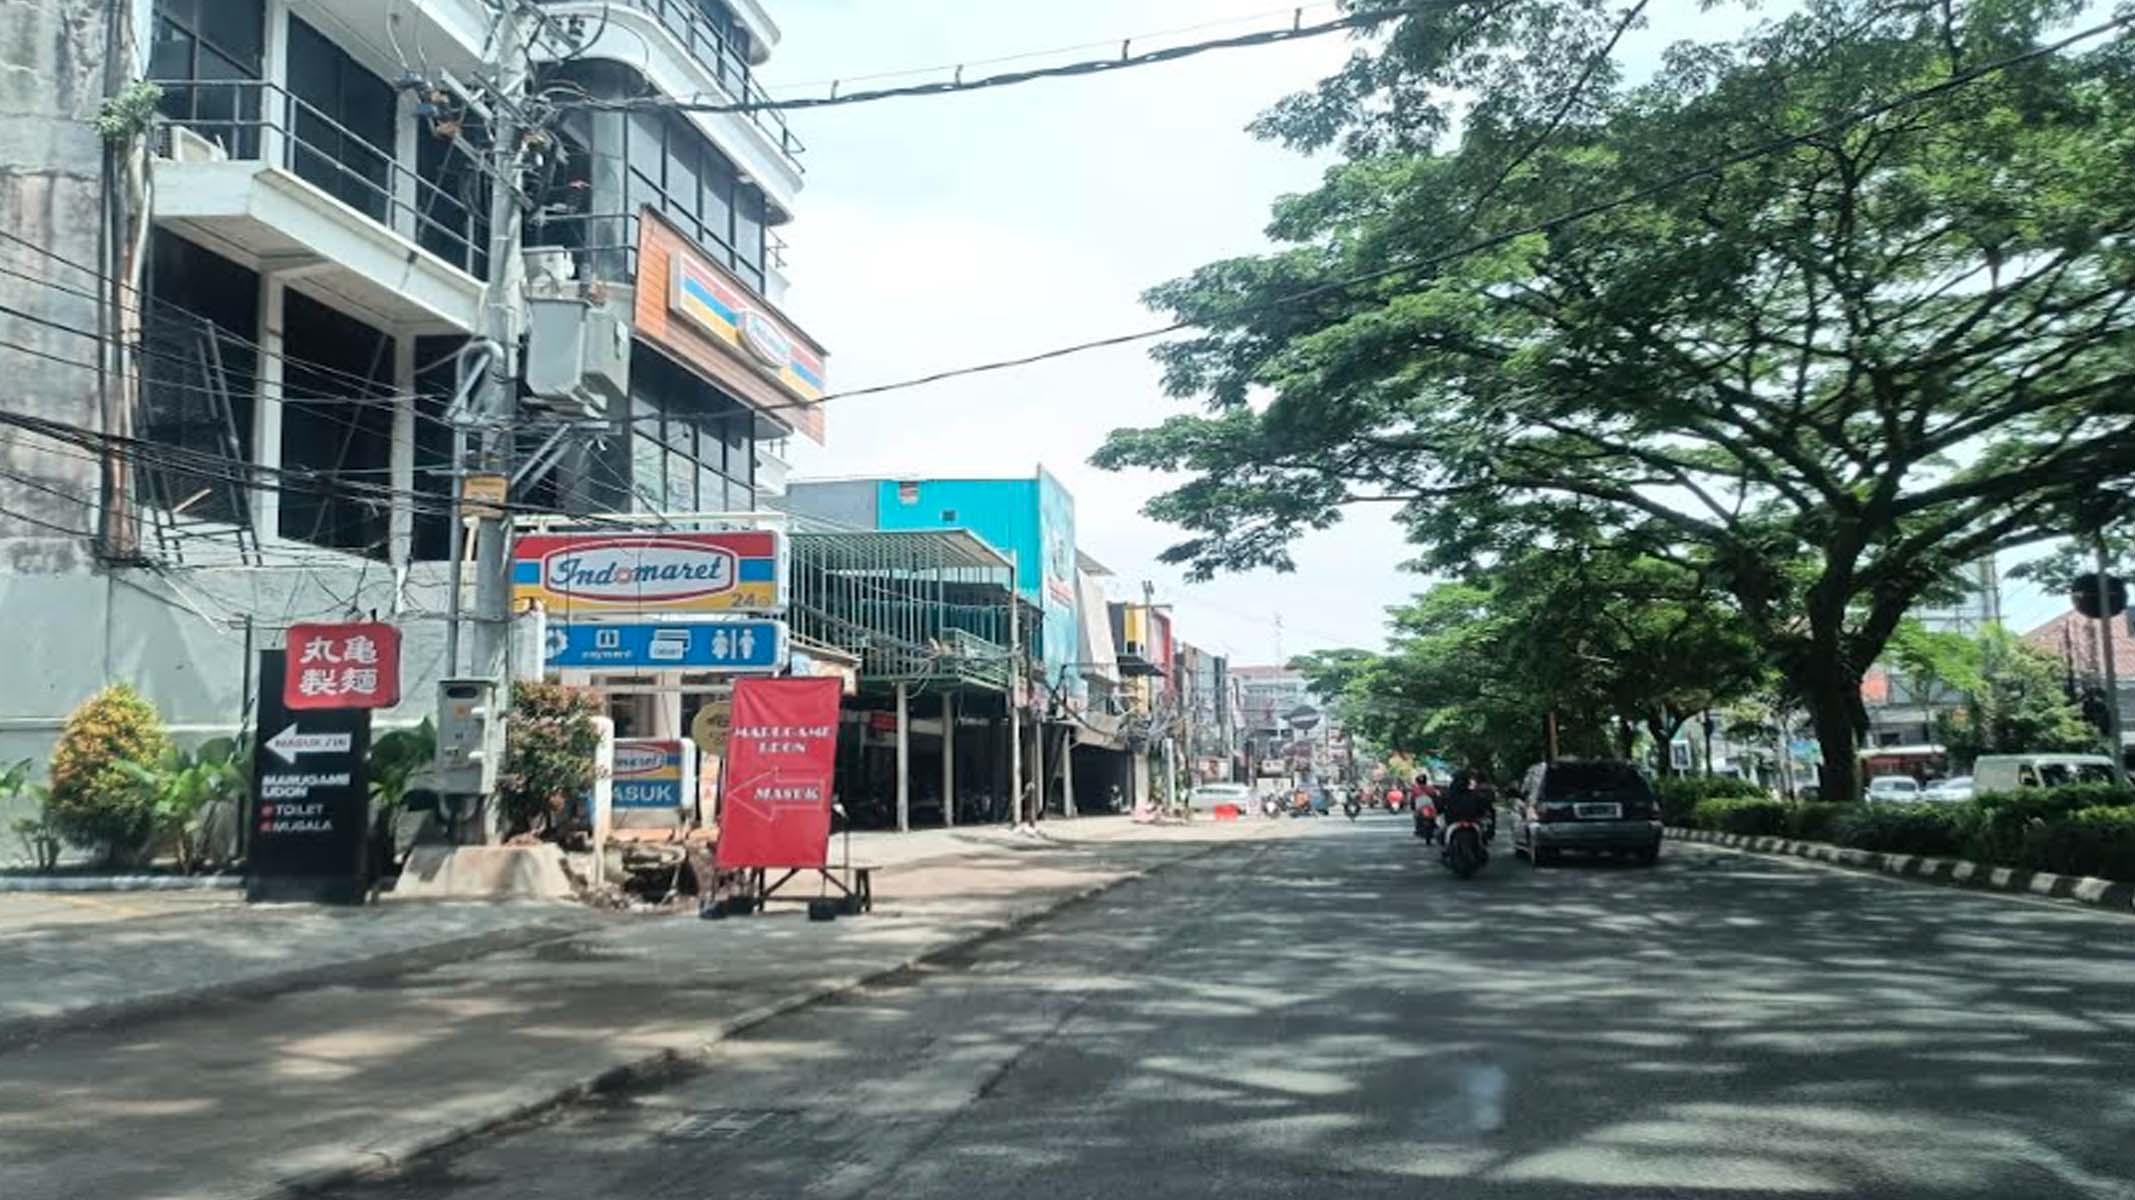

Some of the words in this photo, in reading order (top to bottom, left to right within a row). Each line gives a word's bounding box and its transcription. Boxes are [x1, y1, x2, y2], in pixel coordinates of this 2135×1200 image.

[550, 557, 722, 585] Indomaret
[299, 636, 378, 664] 丸亀
[261, 786, 309, 798] UDON
[613, 784, 673, 802] ASUK
